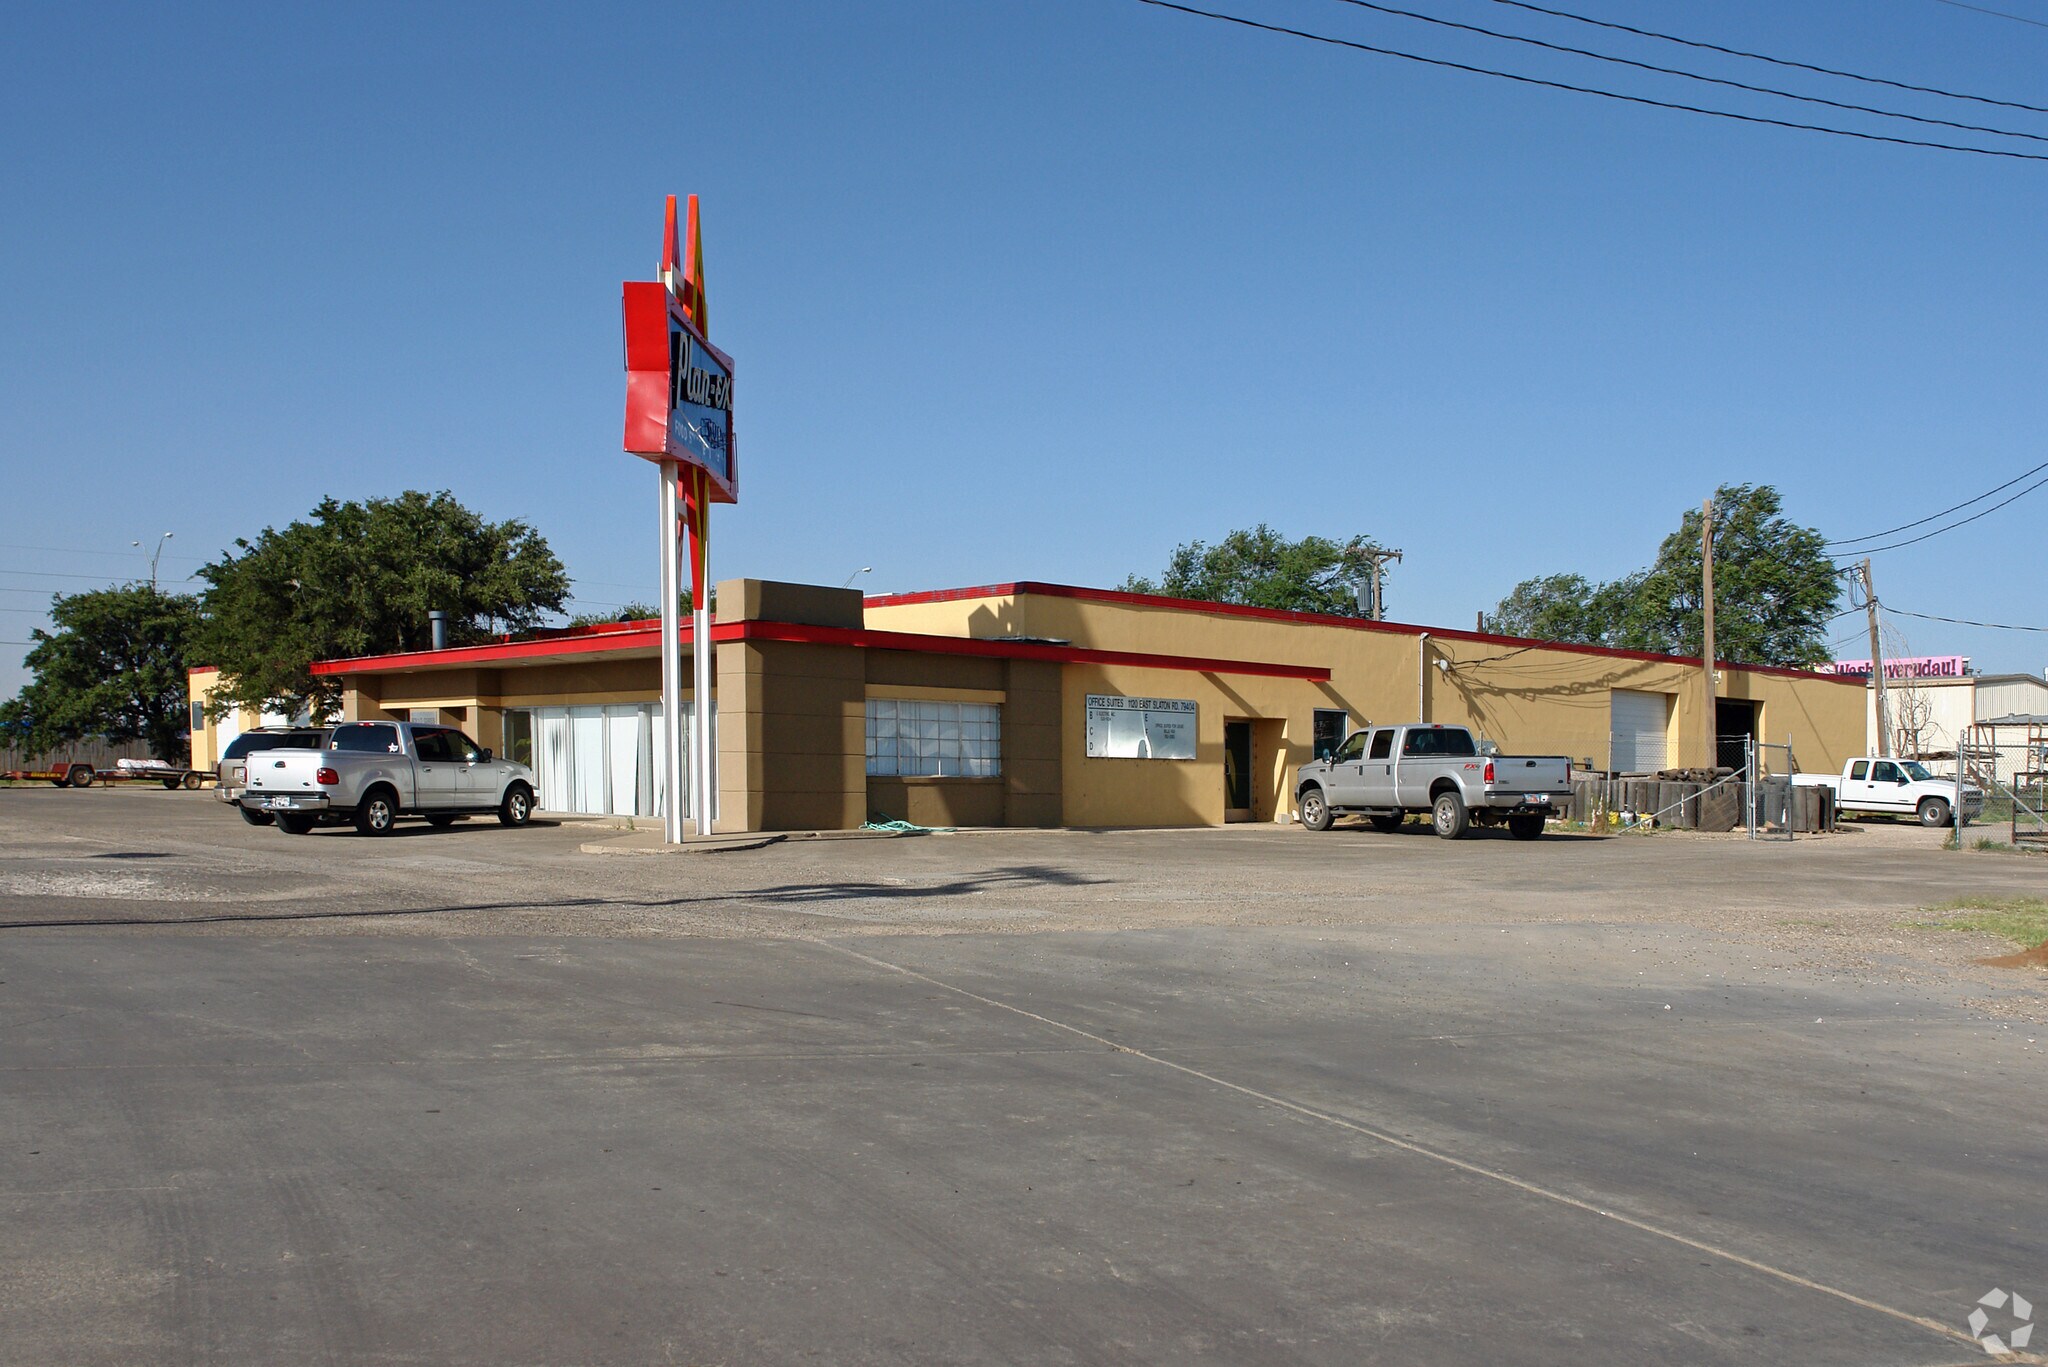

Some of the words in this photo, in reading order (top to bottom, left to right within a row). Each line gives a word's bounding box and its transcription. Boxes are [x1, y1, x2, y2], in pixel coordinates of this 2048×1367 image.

[1088, 697, 1105, 707] OFFICE
[1106, 698, 1124, 708] SUITES
[1139, 700, 1152, 709] EAST
[1153, 700, 1171, 710] SLATON
[1180, 702, 1195, 711] 79404
[1089, 727, 1093, 735] C
[1089, 742, 1093, 750] D
